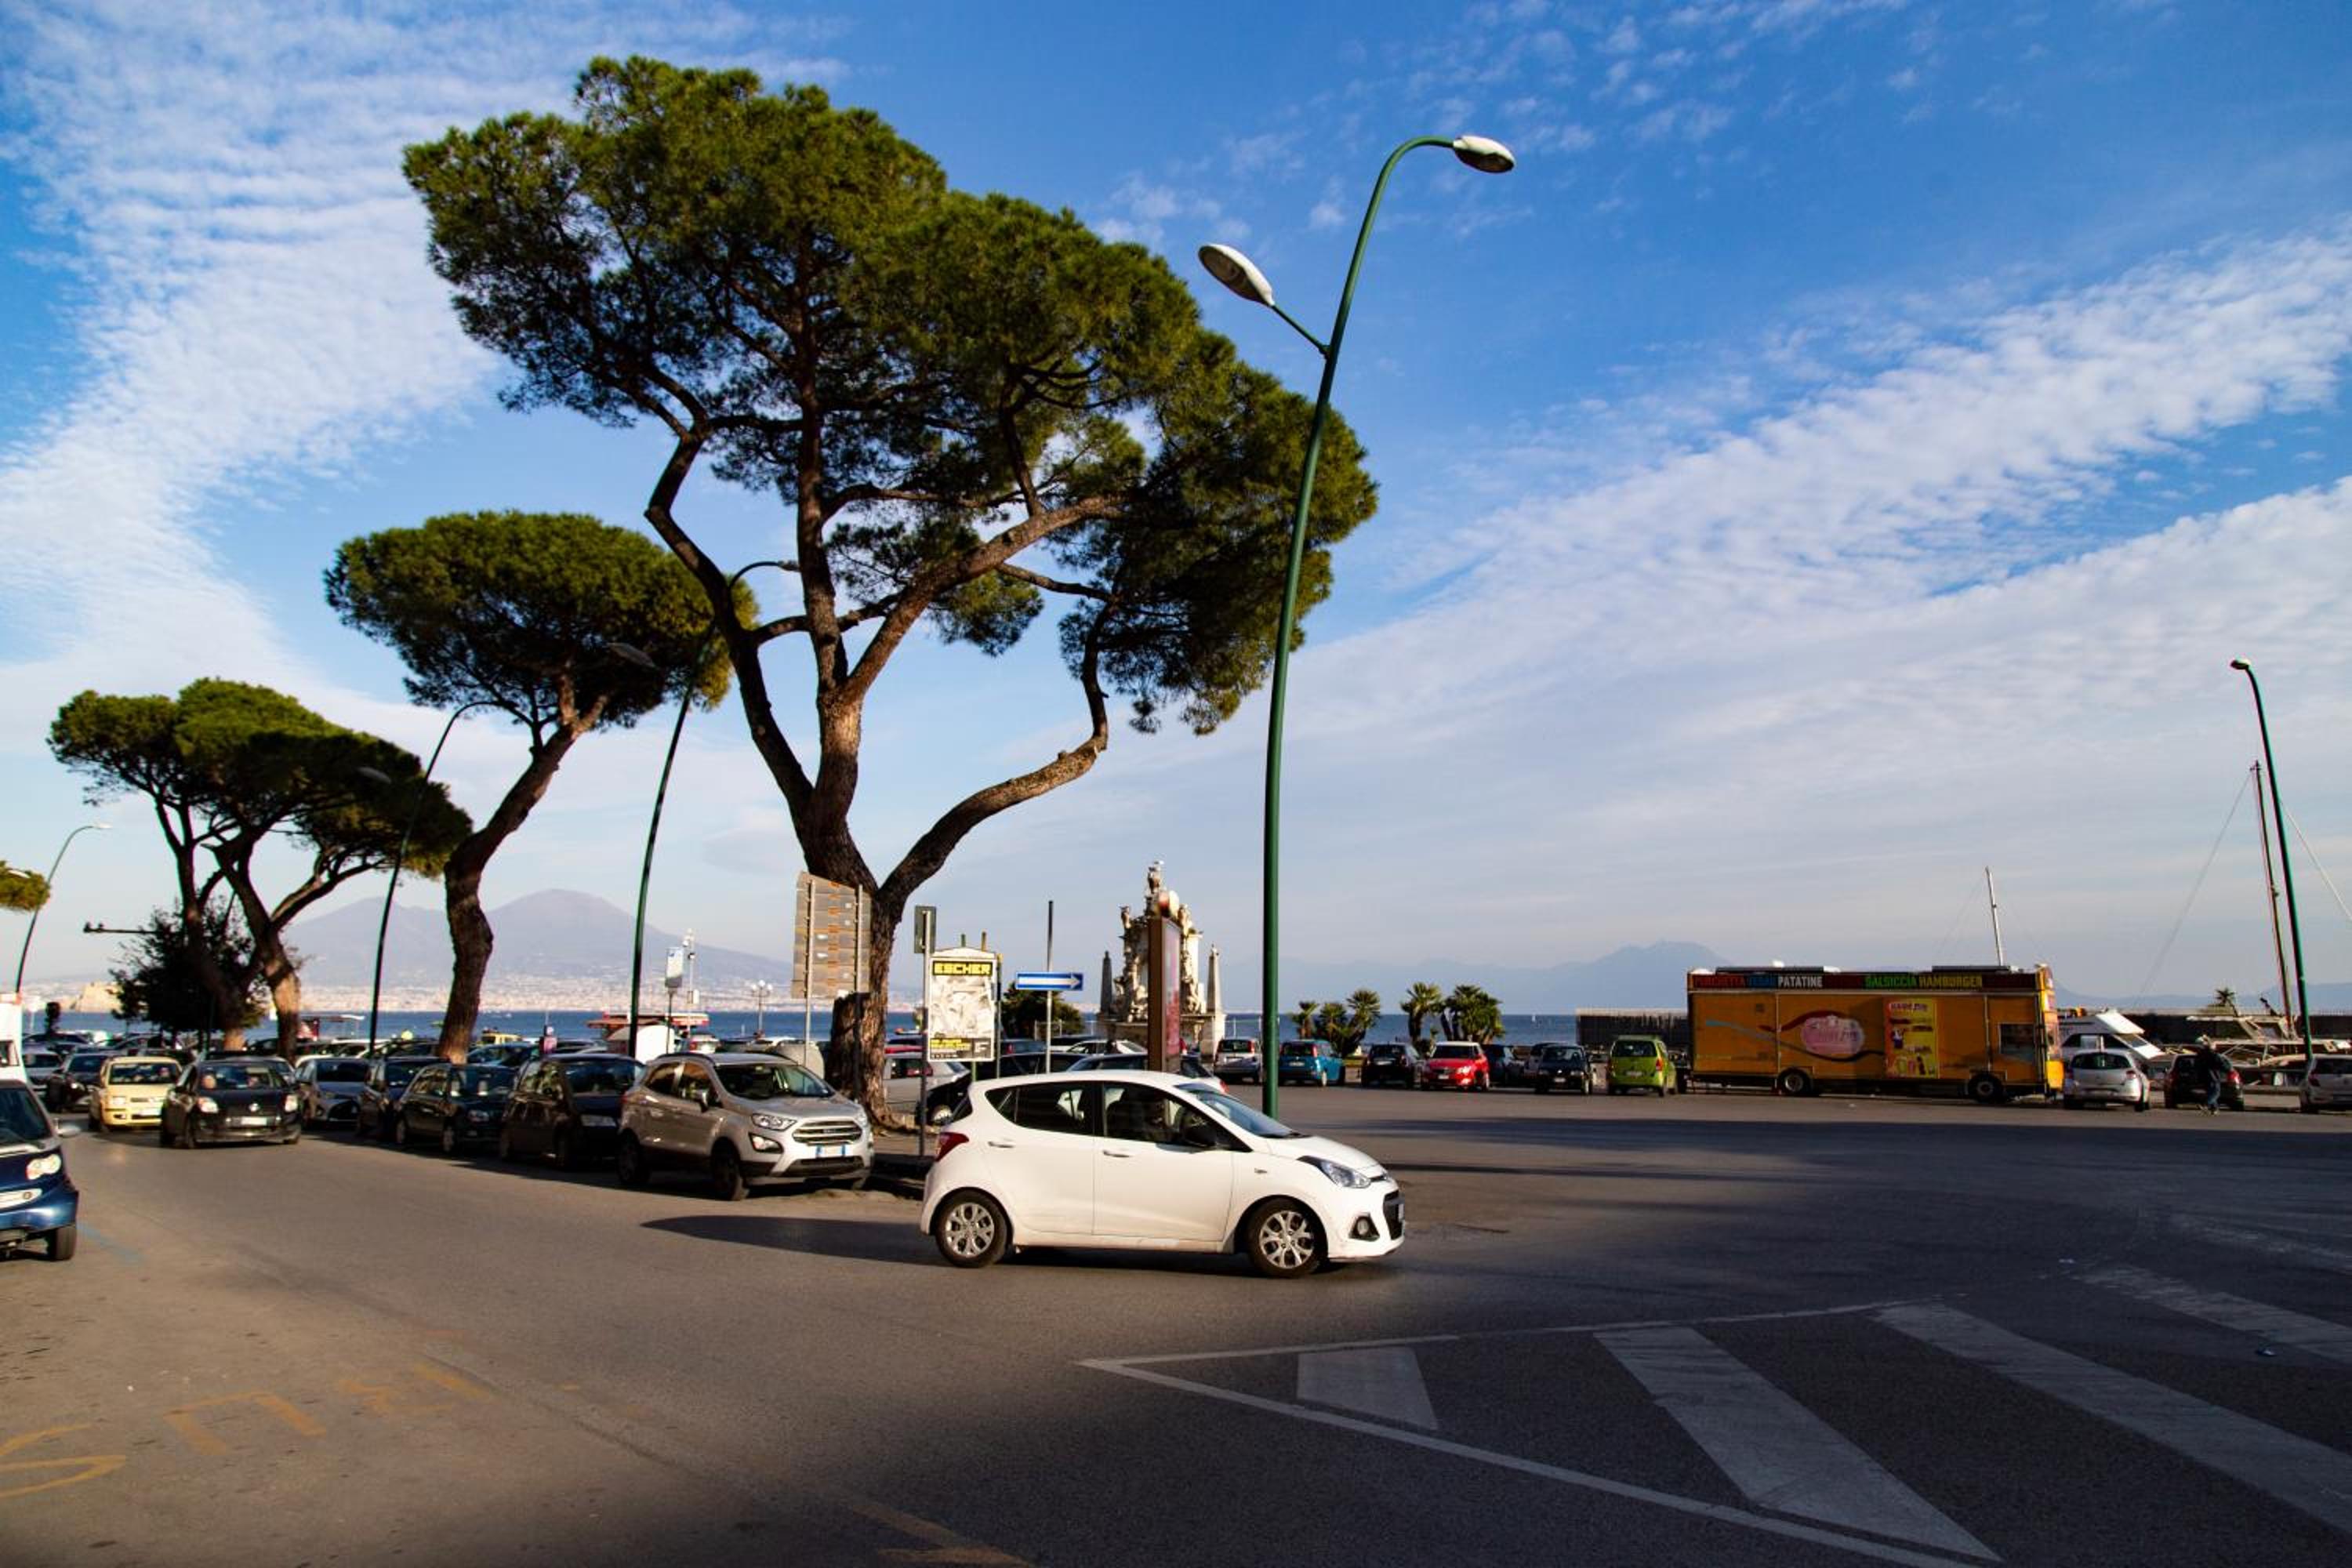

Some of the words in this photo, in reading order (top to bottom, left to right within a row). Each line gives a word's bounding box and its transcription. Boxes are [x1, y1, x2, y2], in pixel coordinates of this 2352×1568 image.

[934, 963, 991, 975] ESCHER
[1777, 976, 1823, 987] PATATINE
[1865, 975, 1917, 988] SALSICCIA
[1918, 975, 1983, 988] HAMBURGER
